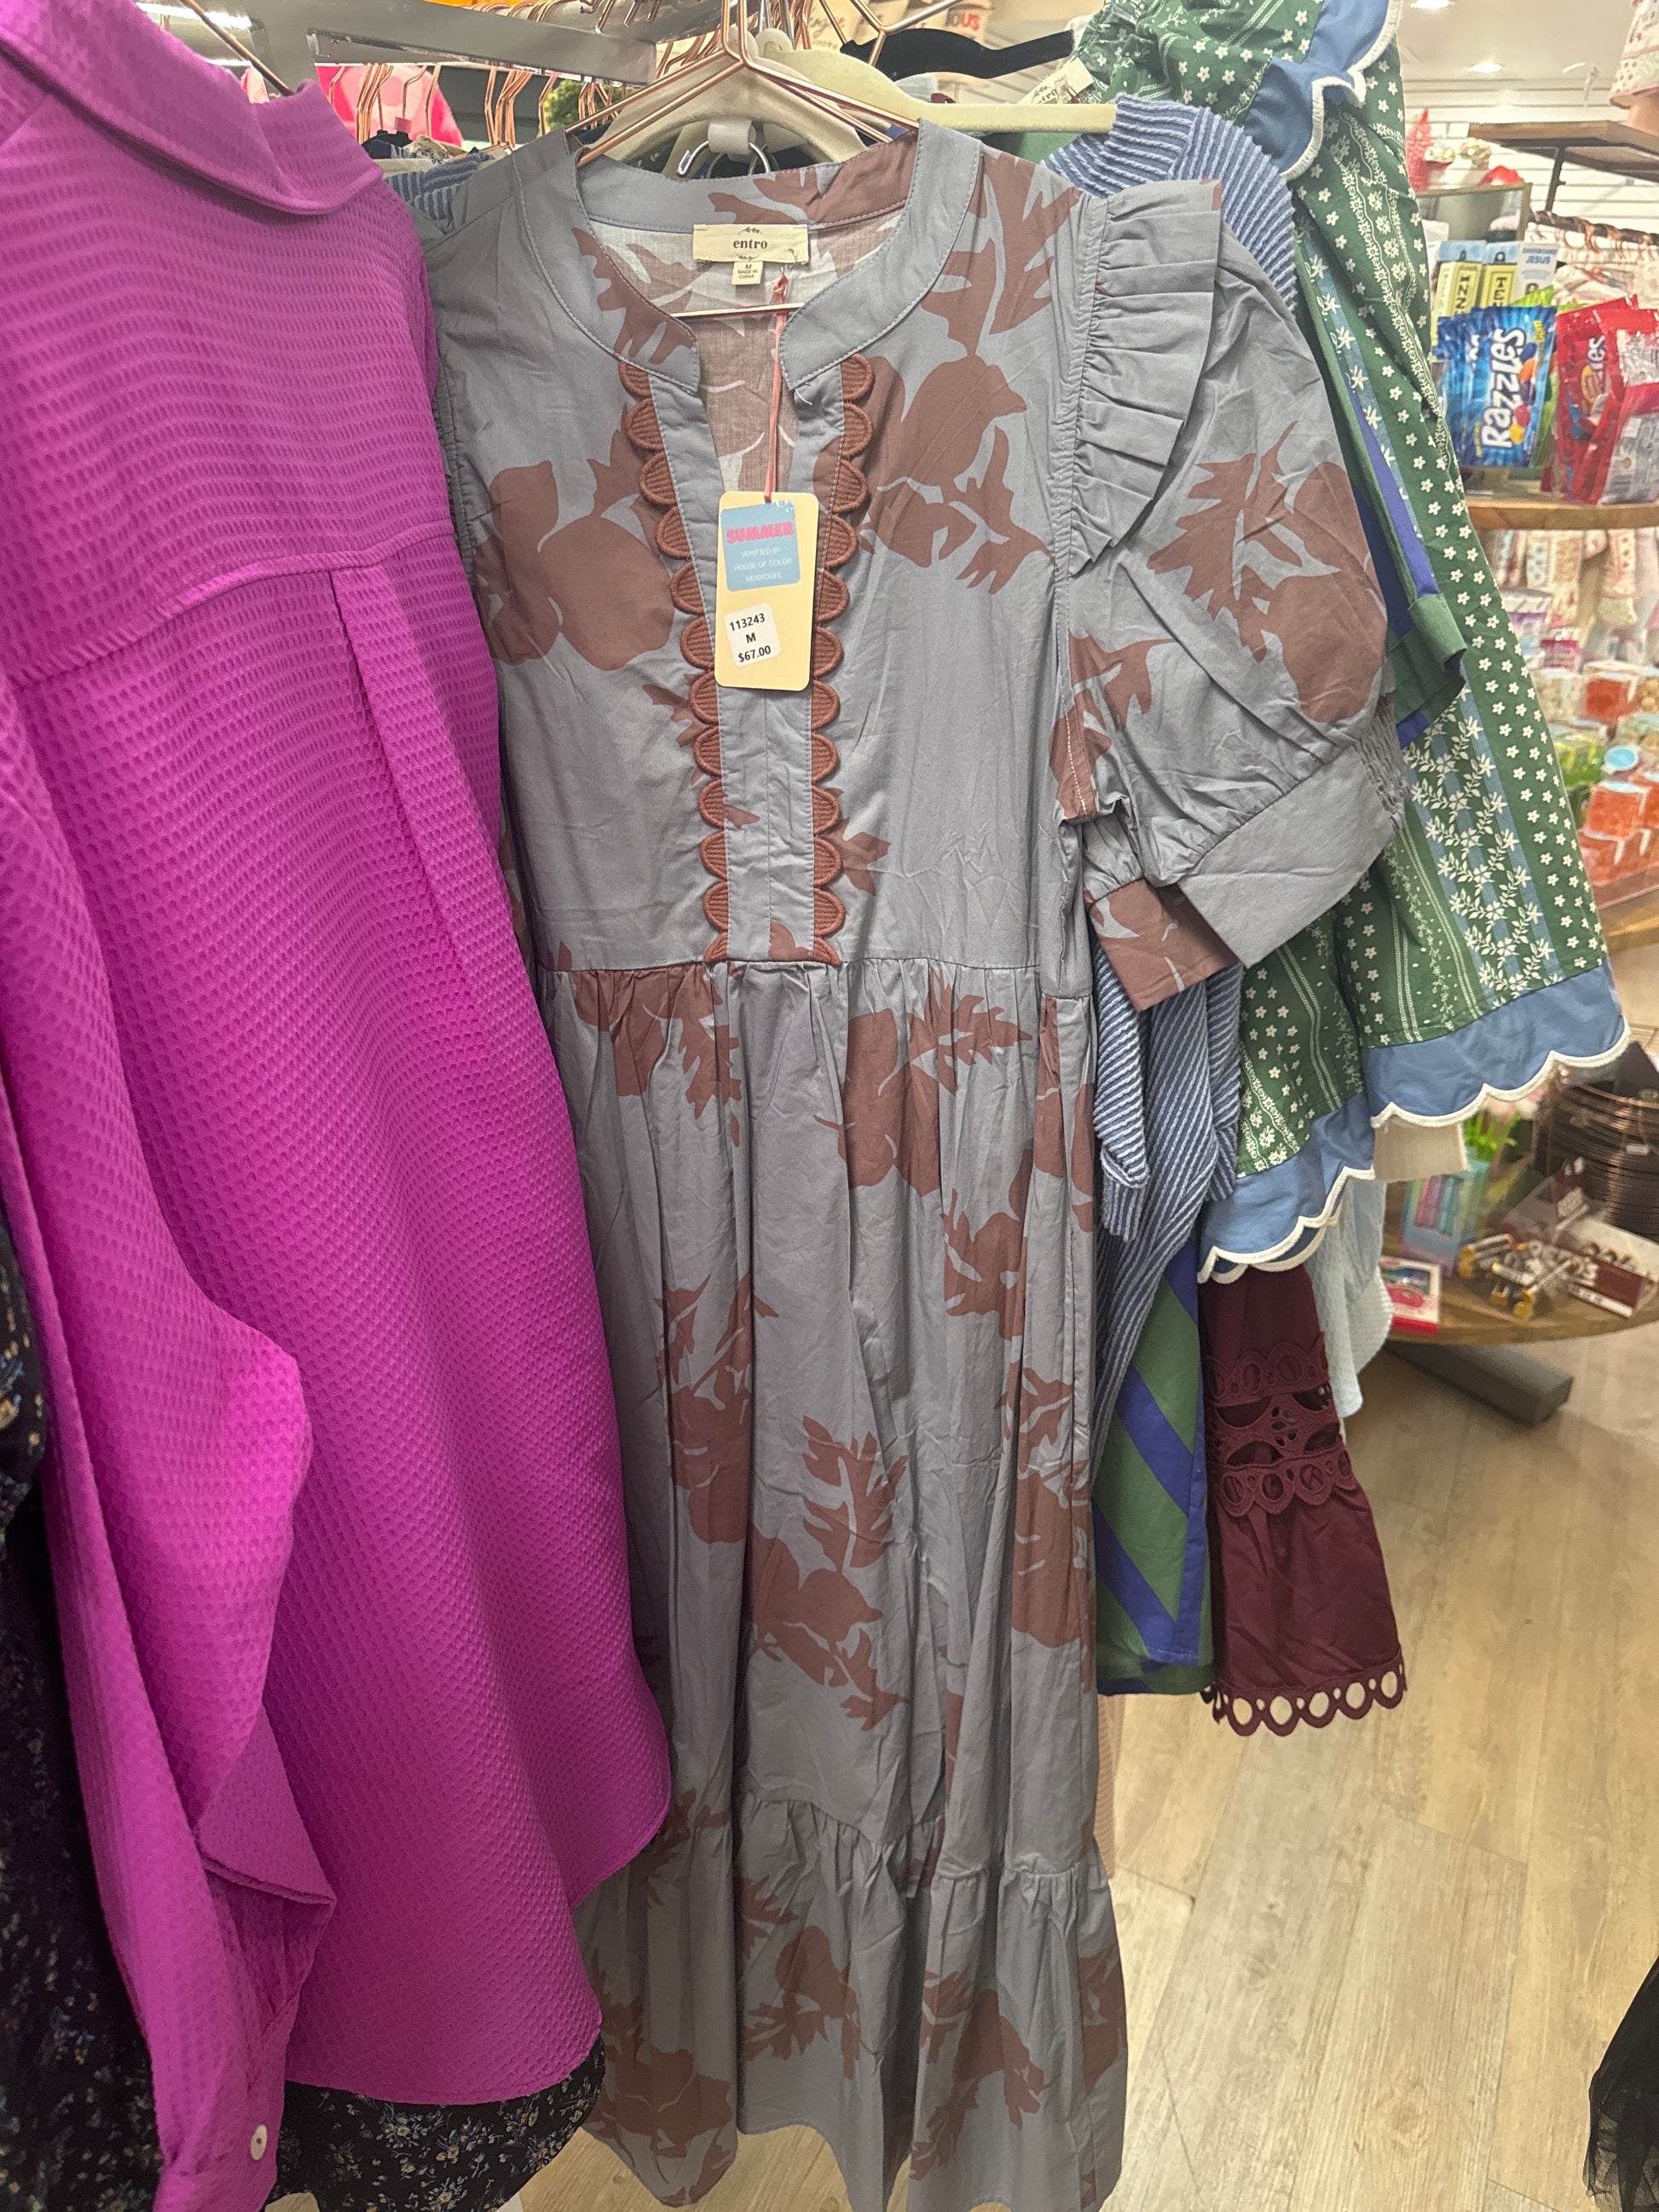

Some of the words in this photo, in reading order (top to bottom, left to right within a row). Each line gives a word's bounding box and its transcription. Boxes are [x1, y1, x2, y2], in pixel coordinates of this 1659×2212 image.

[732, 239, 768, 249] entro
[1526, 255, 1551, 264] JESUS
[1482, 328, 1525, 448] Razzles
[726, 522, 794, 544] SUMMER
[741, 547, 772, 558] VERIFIED
[772, 546, 783, 555] BY
[734, 563, 756, 572] HOUSE
[768, 557, 792, 567] COLOR
[745, 571, 783, 582] MUSKOGEE
[729, 613, 766, 632] 113243
[745, 632, 756, 644] M
[738, 645, 771, 663] $67.00
